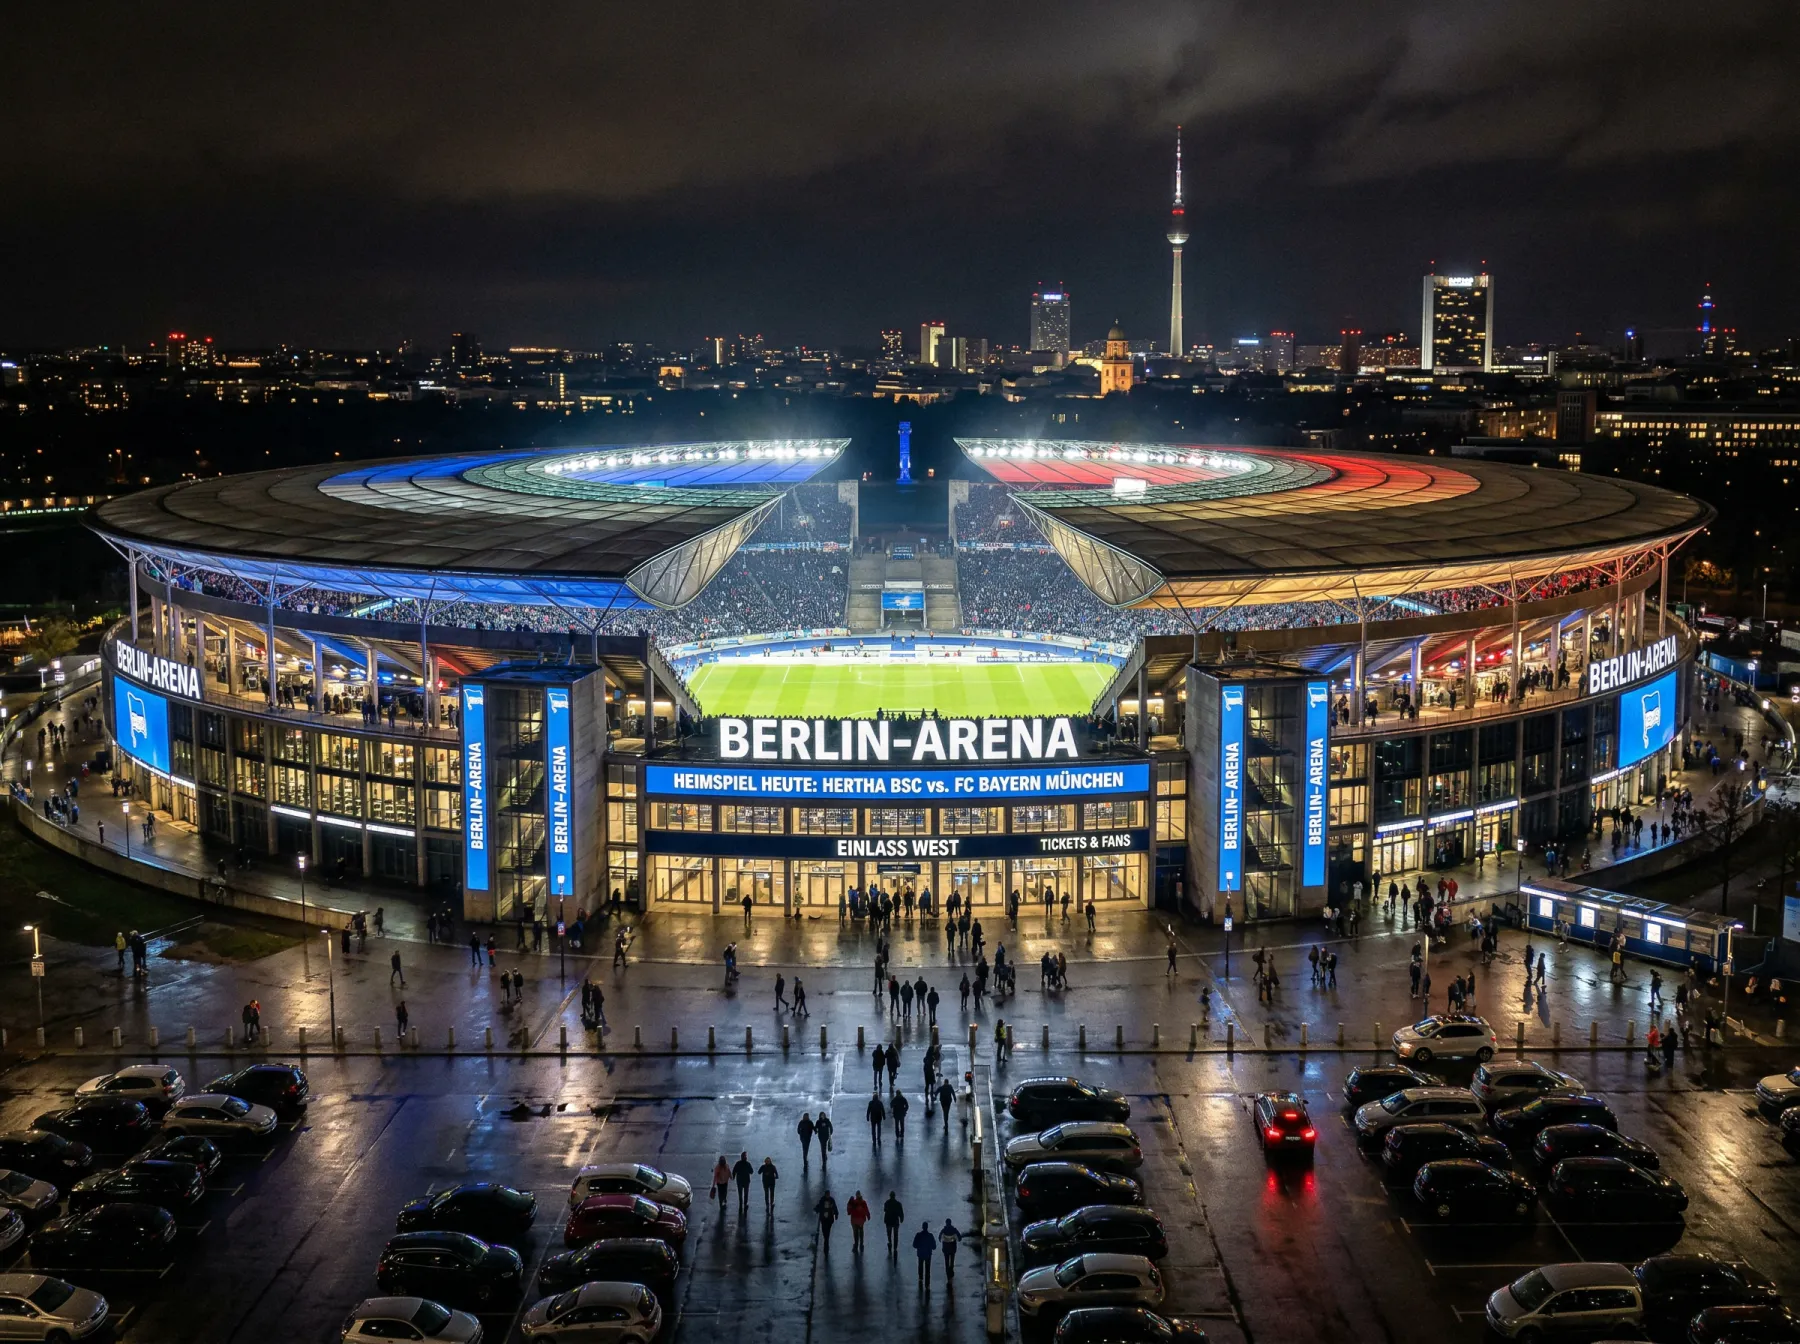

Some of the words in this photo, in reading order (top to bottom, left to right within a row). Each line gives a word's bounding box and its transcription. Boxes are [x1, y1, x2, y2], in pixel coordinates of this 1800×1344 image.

[116, 639, 201, 700] BERLIN-ARENA
[1589, 634, 1677, 694] BERLIN-ARENA
[719, 717, 1079, 761] BERLIN-ARENA
[468, 742, 484, 850] BERLIN-ARENA
[552, 745, 568, 854] BERLIN-ARENA
[674, 772, 757, 791] HEIMSPIEL
[761, 776, 818, 792] HEUTE:
[822, 777, 886, 793] HERTHA
[890, 777, 922, 793] BSC
[926, 780, 949, 793] vs.
[954, 776, 974, 793] FC
[979, 775, 1041, 792] BAYERN
[1045, 770, 1124, 790] MÜNCHEN
[1223, 742, 1239, 850] BERLIN-ARENA
[1308, 738, 1324, 846] BERLIN-ARENA
[837, 839, 908, 857] EINLASS
[911, 839, 960, 857] WEST
[1040, 836, 1087, 851] TICKETS
[1089, 836, 1099, 849] &
[1101, 834, 1131, 848] FANS
